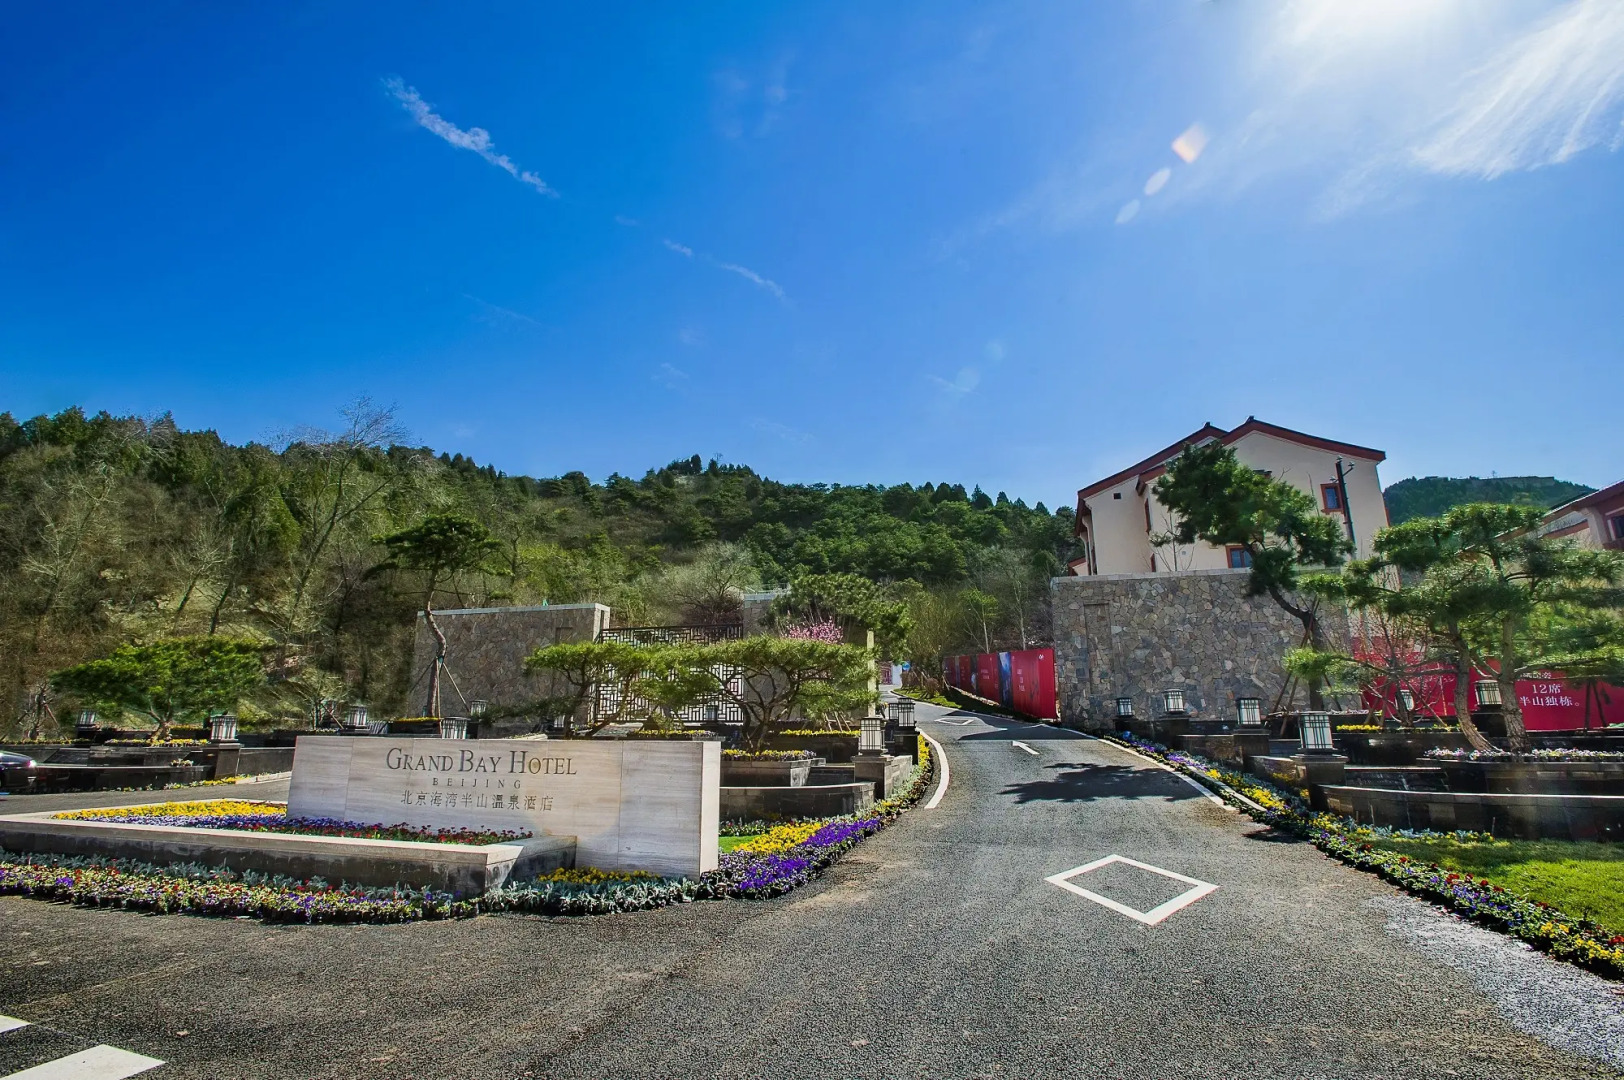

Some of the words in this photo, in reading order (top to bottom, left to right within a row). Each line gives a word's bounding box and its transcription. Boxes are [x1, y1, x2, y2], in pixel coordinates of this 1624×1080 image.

[1532, 683, 1562, 694] 12席
[386, 747, 453, 771] GRAND
[458, 749, 501, 772] BAY
[508, 750, 578, 775] HOTEL
[432, 777, 521, 789] BEIJING
